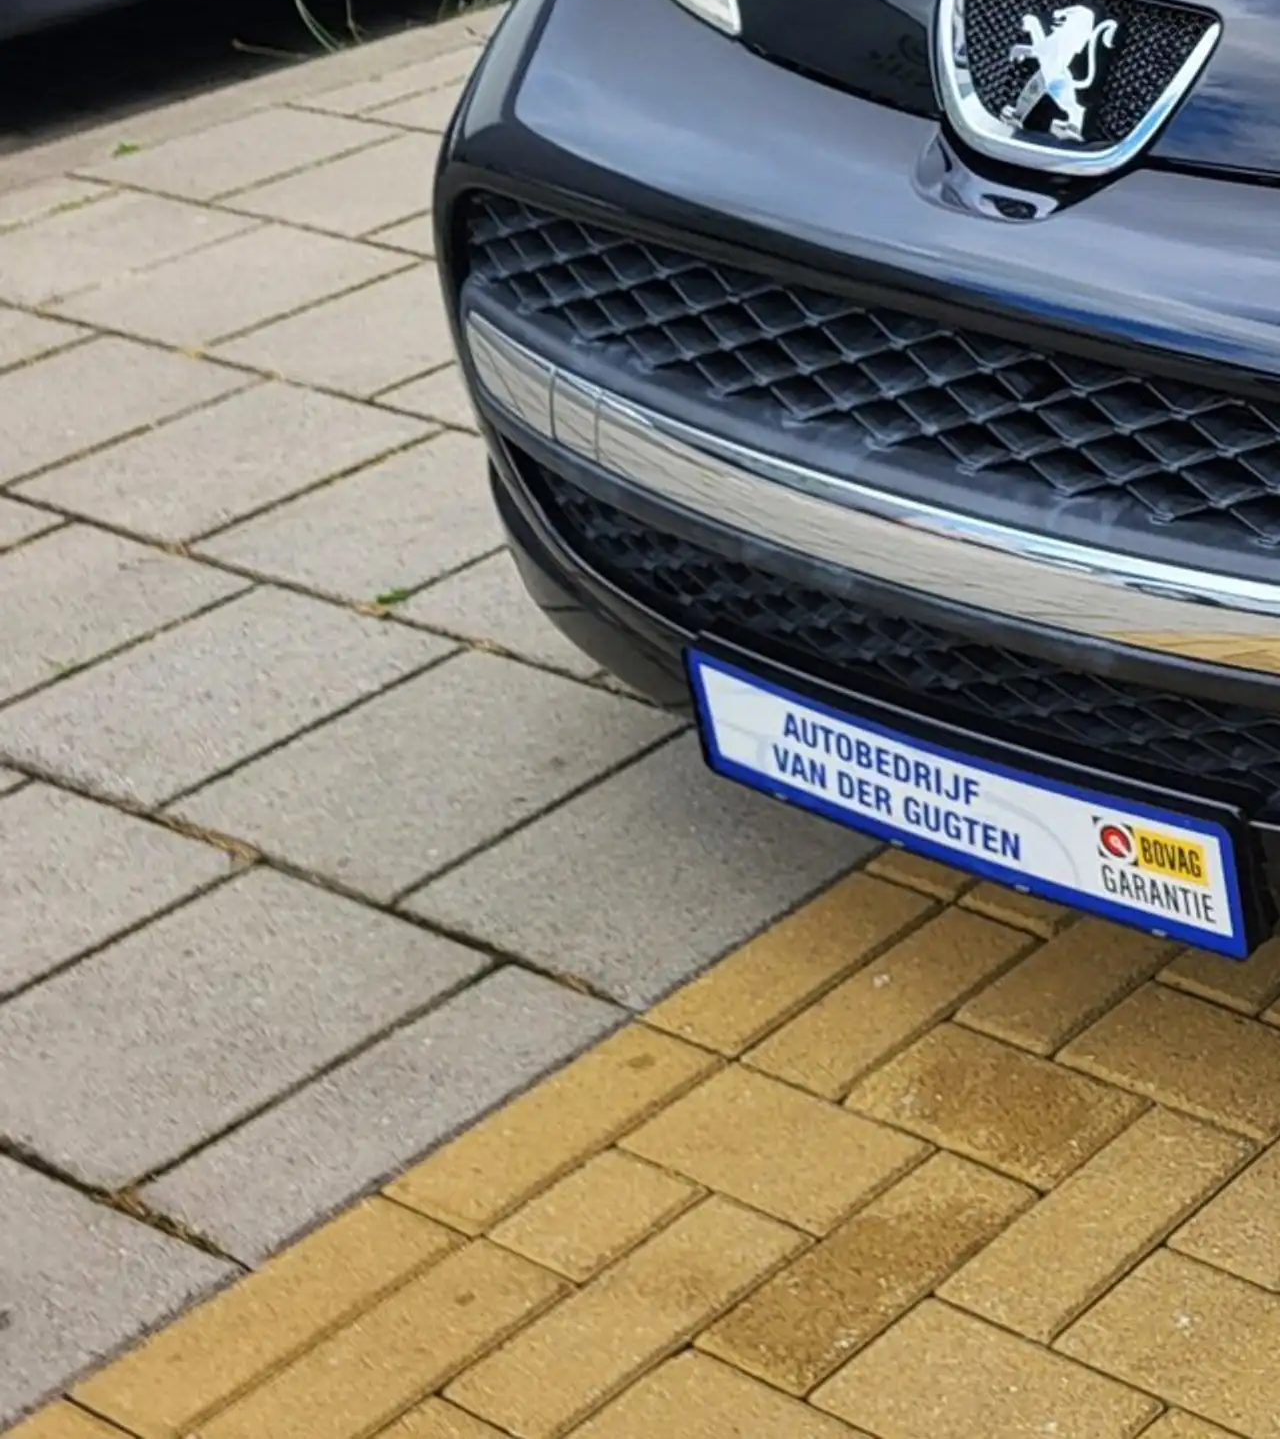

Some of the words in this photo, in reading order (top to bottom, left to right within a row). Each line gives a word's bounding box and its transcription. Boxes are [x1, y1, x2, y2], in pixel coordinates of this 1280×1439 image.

[783, 712, 980, 806] AUTOBEDRIJF
[772, 743, 828, 790] VAN
[837, 770, 893, 816] DER
[903, 795, 1021, 861] GUGTEN
[1102, 864, 1217, 924] GARANTIE
[1140, 836, 1202, 879] BOVAG
